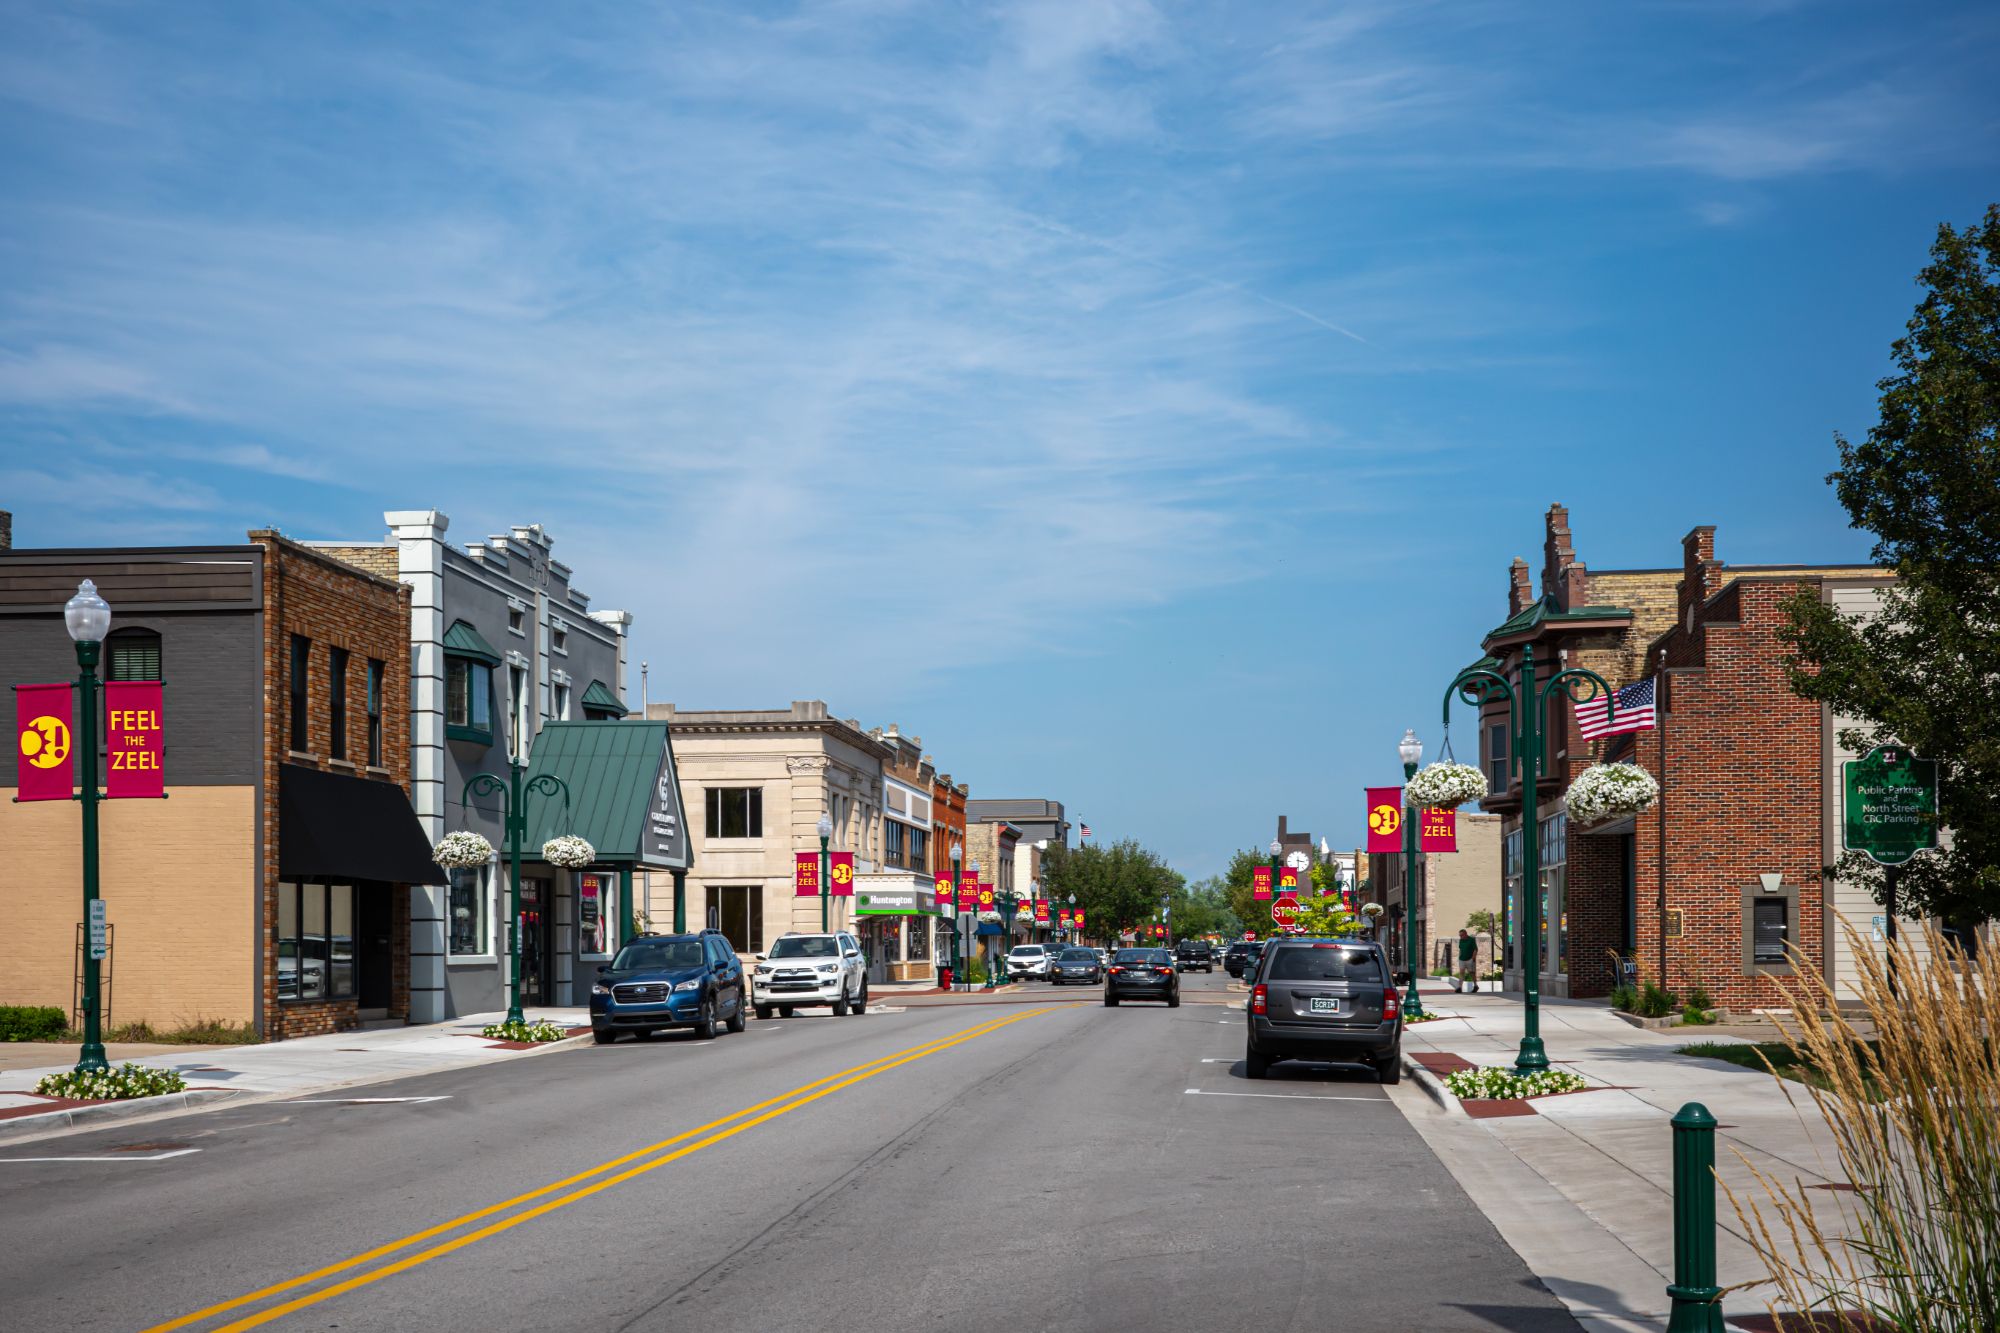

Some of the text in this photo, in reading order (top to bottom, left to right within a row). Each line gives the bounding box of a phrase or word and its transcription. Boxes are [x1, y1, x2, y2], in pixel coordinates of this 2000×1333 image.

[111, 710, 160, 731] FEEL
[124, 735, 145, 747] THE
[111, 751, 160, 770] ZEEL
[1858, 785, 1924, 796] Public Parking
[1862, 804, 1919, 813] North Street
[1431, 816, 1445, 824] THE
[1863, 814, 1919, 824] CRC Parking
[1423, 825, 1454, 837] ZEEL
[797, 862, 817, 872] FEEL
[798, 878, 817, 886] ZEEL
[1254, 874, 1270, 882] FEEL
[870, 895, 913, 906] Huntington
